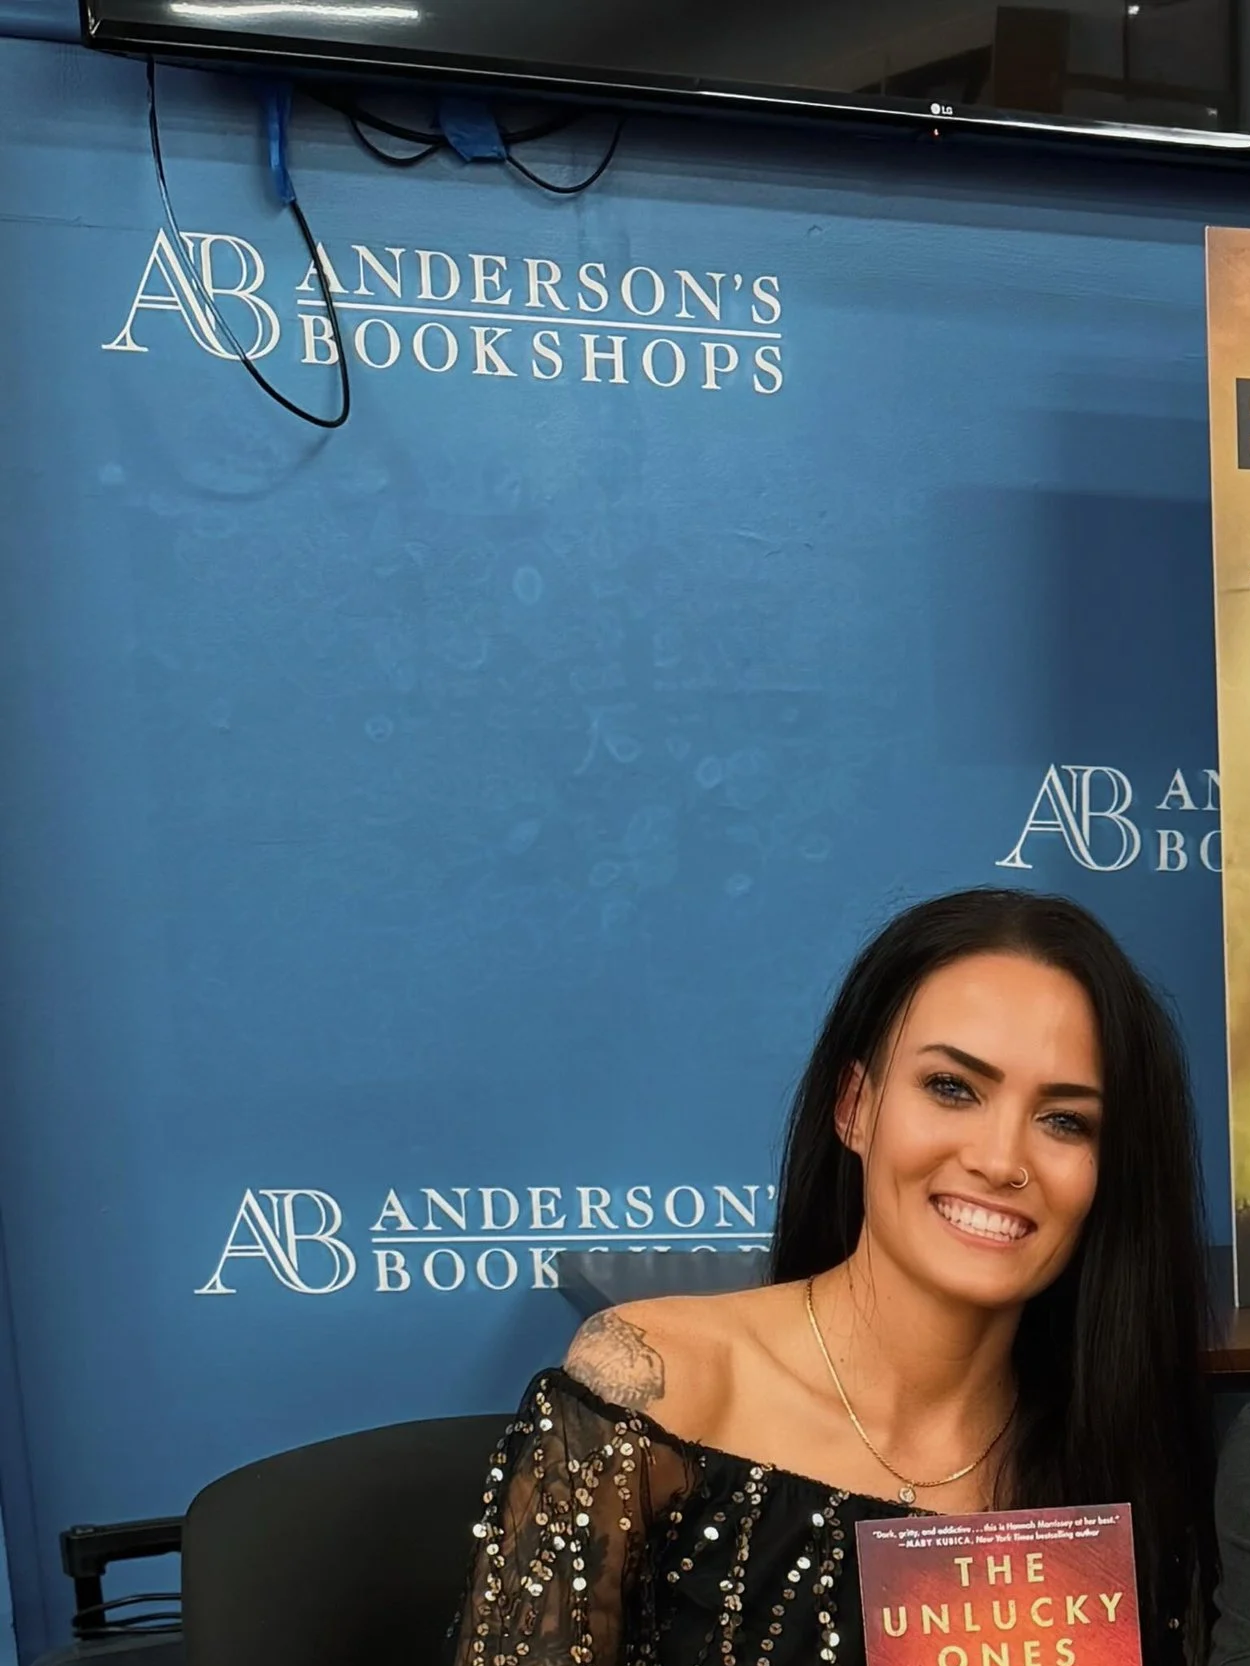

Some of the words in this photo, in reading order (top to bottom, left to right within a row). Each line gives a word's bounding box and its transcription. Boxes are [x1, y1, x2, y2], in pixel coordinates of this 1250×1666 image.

[941, 104, 953, 115] LG
[296, 242, 782, 324] ANDERSON'S
[301, 313, 784, 394] BOOKSHOPS
[370, 1185, 775, 1233] ANDERSON'
[921, 1526, 936, 1536] and
[1006, 1520, 1036, 1531] Hannah
[1083, 1516, 1096, 1525] her
[975, 1535, 995, 1544] New
[995, 1532, 1012, 1543] York
[1013, 1531, 1034, 1541] Times
[1035, 1529, 1074, 1540] bestselling
[1075, 1527, 1100, 1537] author
[954, 1551, 1045, 1588] THE
[882, 1591, 1123, 1638] UNLUCKY
